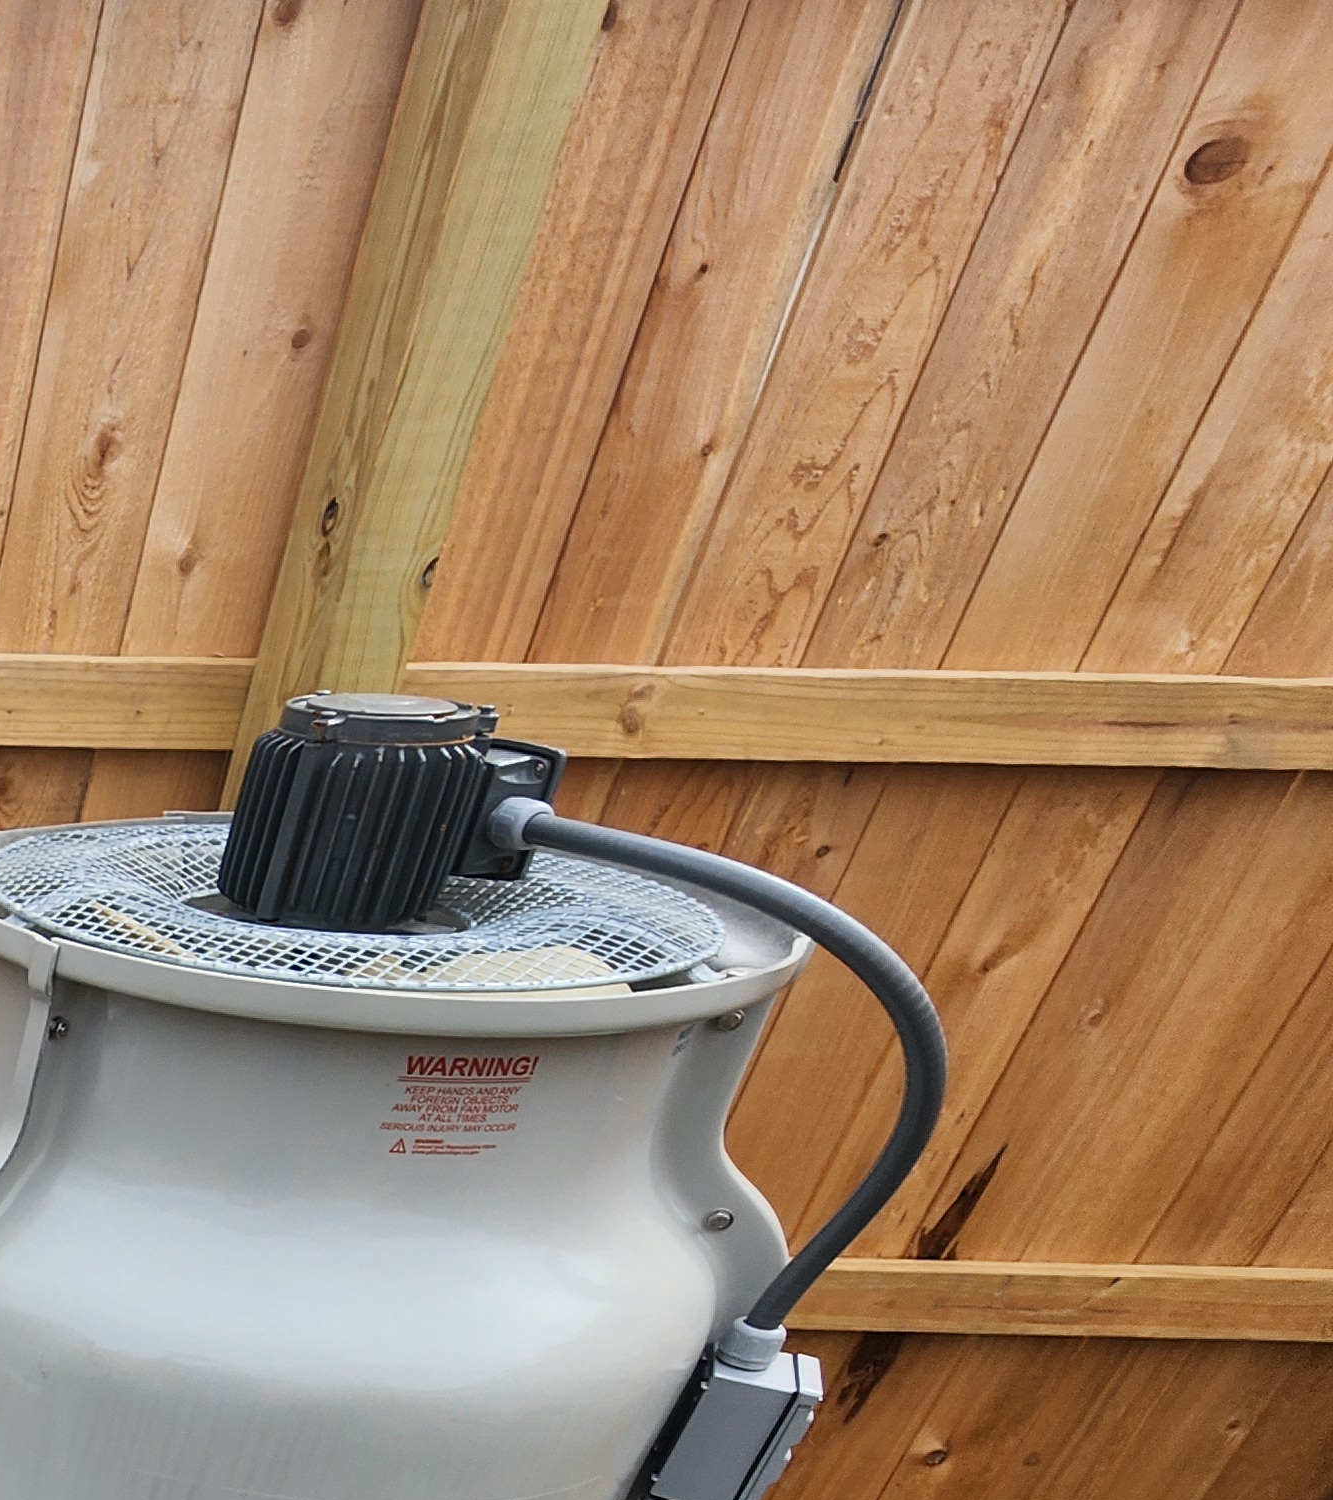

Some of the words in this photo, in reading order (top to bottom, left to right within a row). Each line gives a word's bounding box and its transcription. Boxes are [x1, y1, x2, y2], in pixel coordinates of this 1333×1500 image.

[405, 1055, 540, 1076] WARNING!
[404, 1085, 436, 1095] KEEP
[436, 1086, 474, 1096] HANDS
[476, 1087, 500, 1096] AND
[499, 1086, 522, 1095] ANY
[410, 1095, 460, 1104] FOREIGN
[462, 1095, 510, 1104] OBJECTS
[391, 1103, 424, 1112] AWAY
[425, 1104, 458, 1113] FROM
[460, 1104, 481, 1113] FAN
[482, 1103, 519, 1113] MOTOR
[418, 1113, 434, 1122] AT
[433, 1113, 452, 1122] ALL
[379, 1121, 425, 1132] SERIOUS
[426, 1123, 460, 1132] INJURY
[462, 1123, 481, 1132] MAY
[483, 1122, 517, 1132] OCCUR
